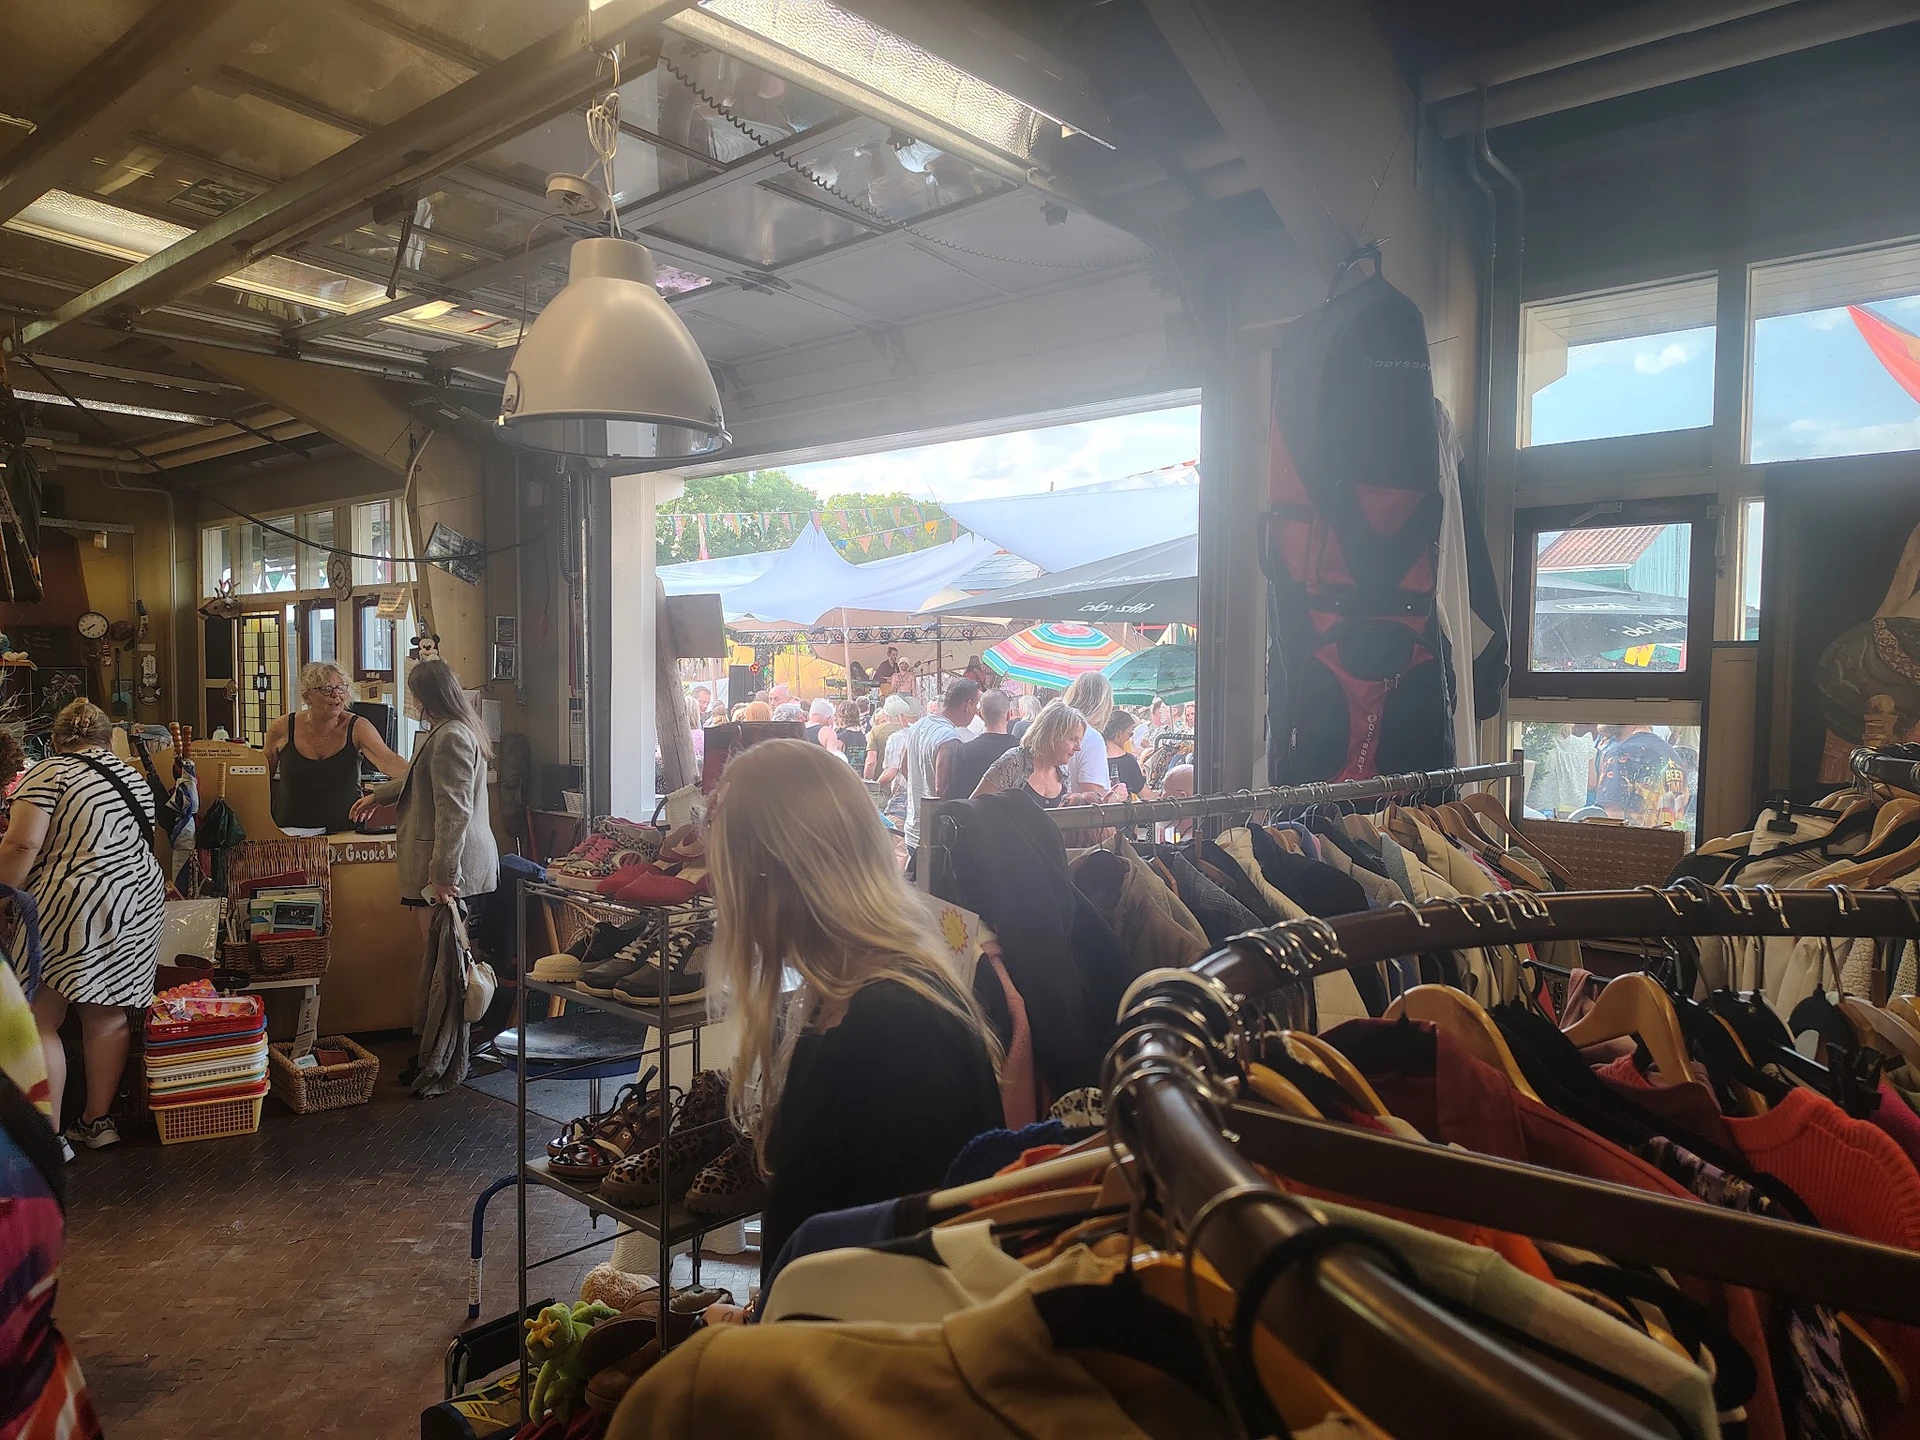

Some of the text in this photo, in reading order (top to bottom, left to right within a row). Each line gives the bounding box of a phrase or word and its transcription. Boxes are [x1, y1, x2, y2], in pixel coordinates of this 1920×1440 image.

[1374, 360, 1432, 372] ODYSSEY
[1357, 723, 1375, 773] ODYSSEY
[1665, 769, 1684, 782] BEER
